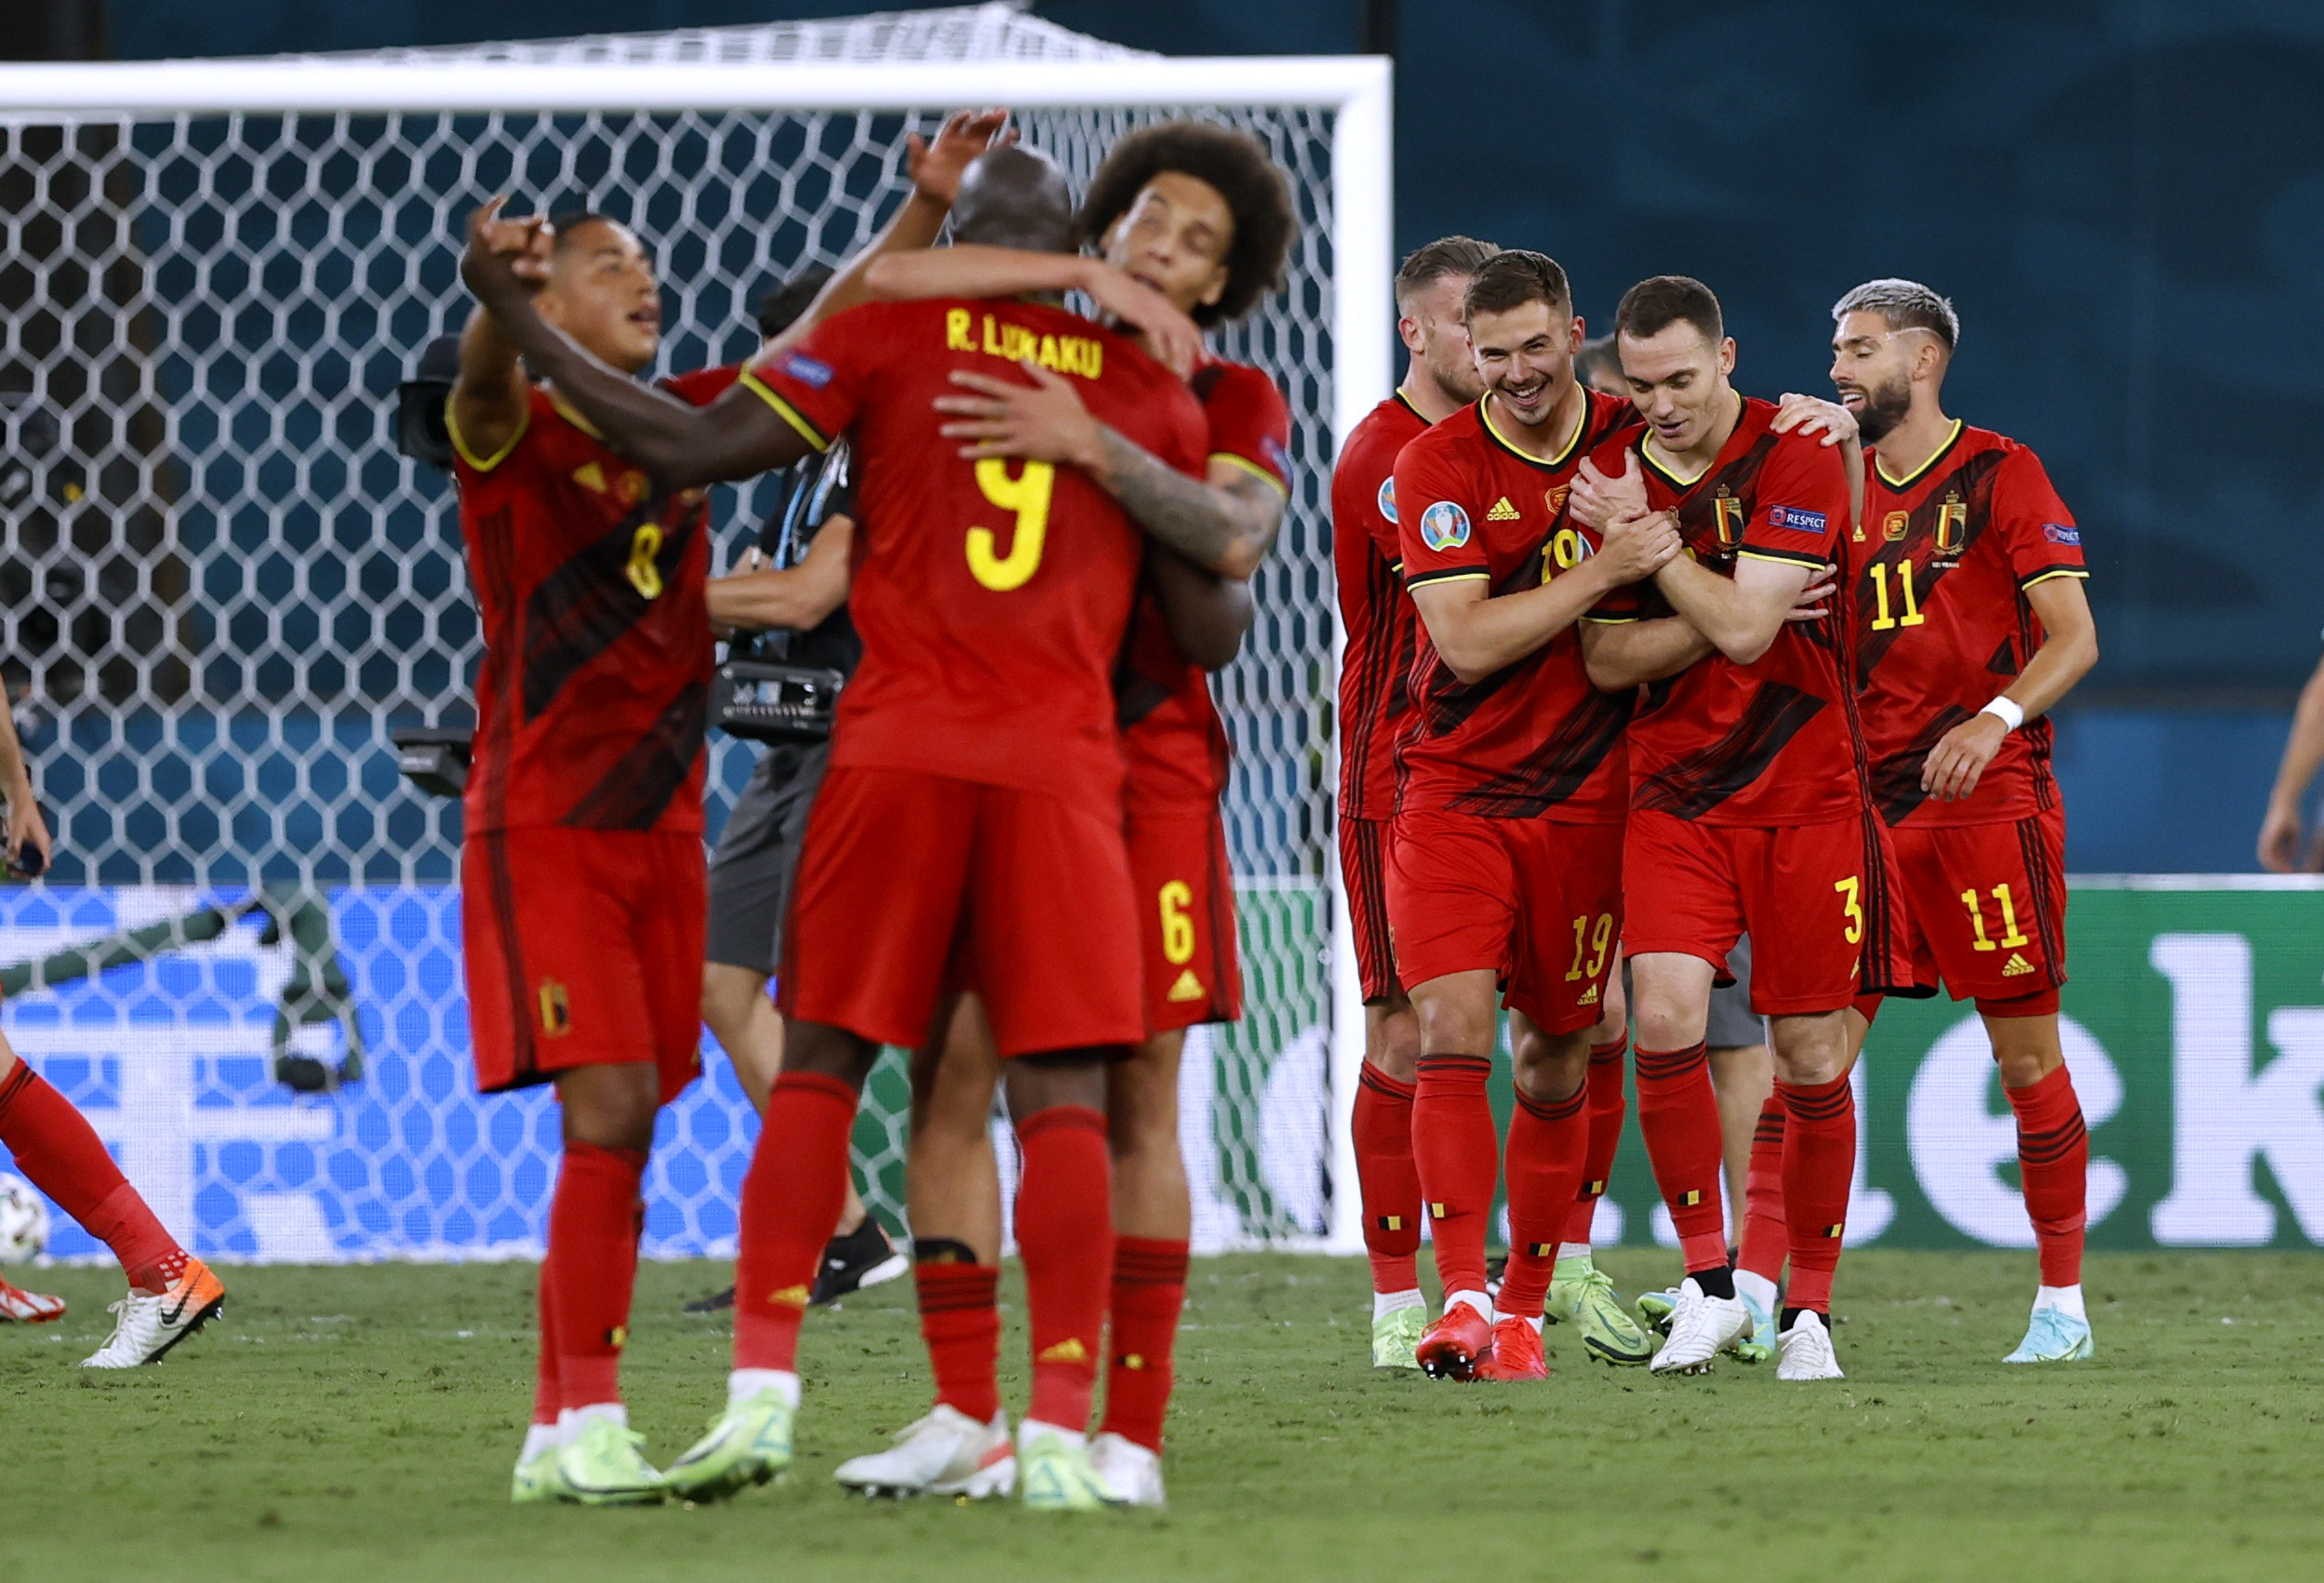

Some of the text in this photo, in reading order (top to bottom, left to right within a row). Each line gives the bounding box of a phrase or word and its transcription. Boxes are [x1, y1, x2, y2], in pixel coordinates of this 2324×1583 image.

[982, 313, 1103, 379] LUKAKU
[966, 439, 1055, 592] 9
[1486, 512, 1521, 521] adidas
[1786, 513, 1825, 529] RESPECT
[626, 522, 664, 600] 8
[1870, 559, 1925, 631] 11
[1158, 880, 1195, 964] 6
[1835, 875, 1863, 944] 3
[1961, 883, 2028, 951] 11
[1565, 912, 1613, 982] 19
